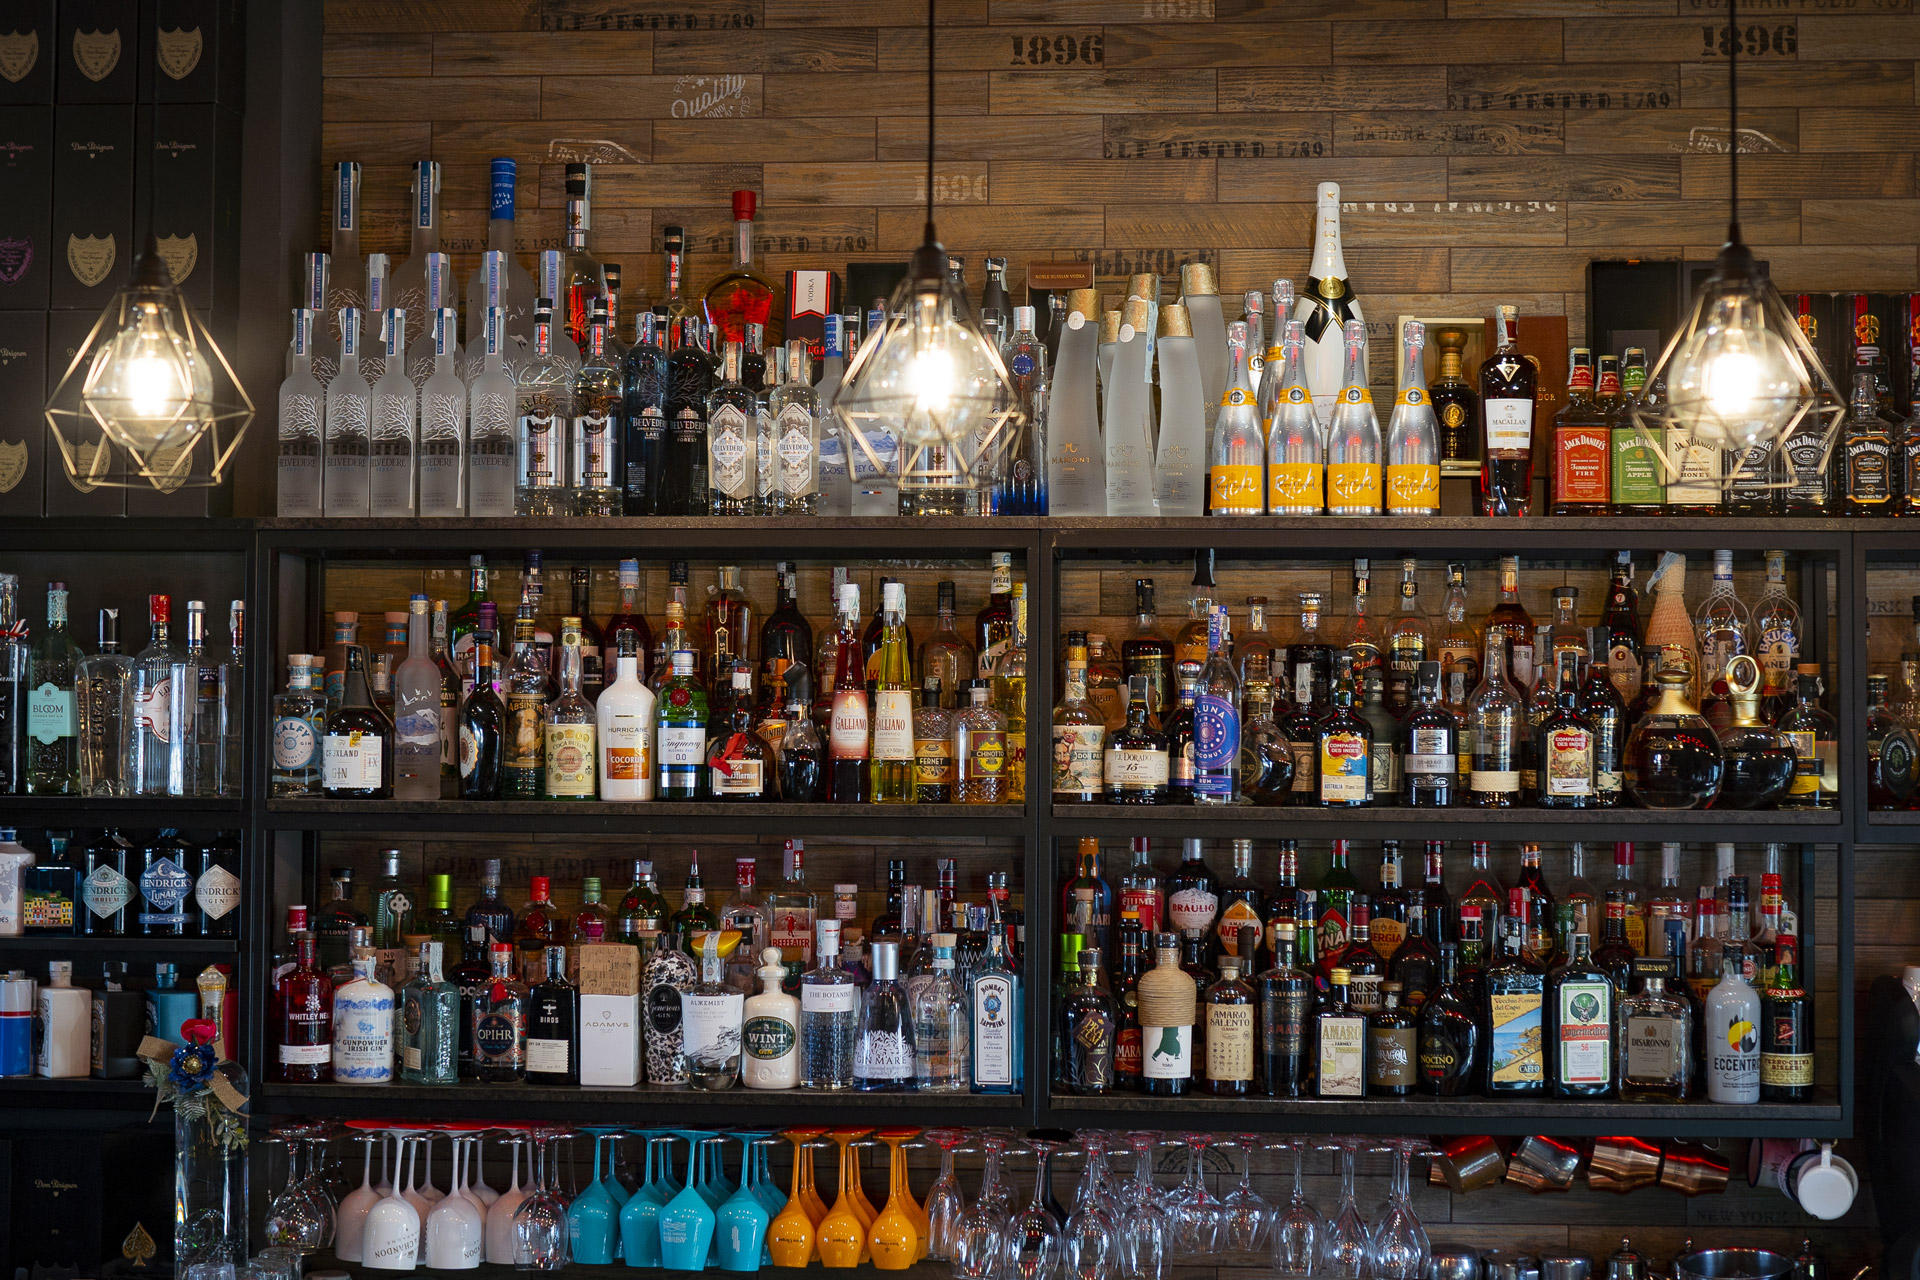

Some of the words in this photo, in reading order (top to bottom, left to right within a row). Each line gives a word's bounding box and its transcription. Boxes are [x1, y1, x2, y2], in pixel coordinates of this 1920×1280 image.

[1700, 24, 1797, 57] 1896
[1009, 34, 1102, 66] 1896
[671, 74, 747, 118] Quality
[1503, 91, 1611, 110] TESTED
[1159, 140, 1265, 158] TESTED
[807, 278, 815, 303] VODKA
[1564, 437, 1581, 451] JACK
[1580, 434, 1607, 451] DANIEL'S
[1618, 437, 1636, 453] JACK
[1784, 438, 1802, 452] JACK
[1849, 444, 1865, 457] JACK
[1864, 441, 1890, 456] DANIEL'S
[327, 457, 367, 468] BELVEDERE
[1051, 456, 1092, 465] MAMONT
[1570, 463, 1599, 471] Tennessee
[1212, 469, 1260, 501] Rich
[1274, 467, 1321, 500] Rich
[1333, 467, 1376, 499] Rich
[1391, 468, 1438, 501] Rich
[32, 704, 64, 714] BLOOM
[835, 716, 867, 731] GALLIANO
[275, 721, 310, 738] MALFY
[610, 756, 646, 764] COCORUM
[918, 757, 944, 765] FERNET
[1123, 752, 1153, 762] DORADO
[331, 766, 348, 779] GIN
[1126, 762, 1139, 772] 15
[140, 879, 193, 888] HENDRICK'S
[151, 889, 178, 903] LUNAR
[773, 938, 810, 949] BEEFEATER
[980, 983, 1005, 994] BOMBAY
[809, 991, 822, 999] THE
[822, 991, 851, 999] BOTANIST
[1504, 1003, 1521, 1011] Capo
[288, 1013, 319, 1021] WHITLEY
[1213, 1010, 1247, 1019] AMARO
[979, 1018, 1006, 1028] SAPPHIRE
[1210, 1018, 1250, 1027] SALENTO
[477, 1029, 514, 1040] OPIHR
[1322, 1025, 1362, 1040] AMARO
[748, 1033, 787, 1044] WINT
[1631, 1038, 1670, 1049] DISARONNO
[1580, 1043, 1589, 1051] 56
[856, 1056, 873, 1065] GIN
[875, 1056, 907, 1065] MARE
[1420, 1055, 1454, 1064] NOCINO
[1518, 1065, 1541, 1073] CAFFO
